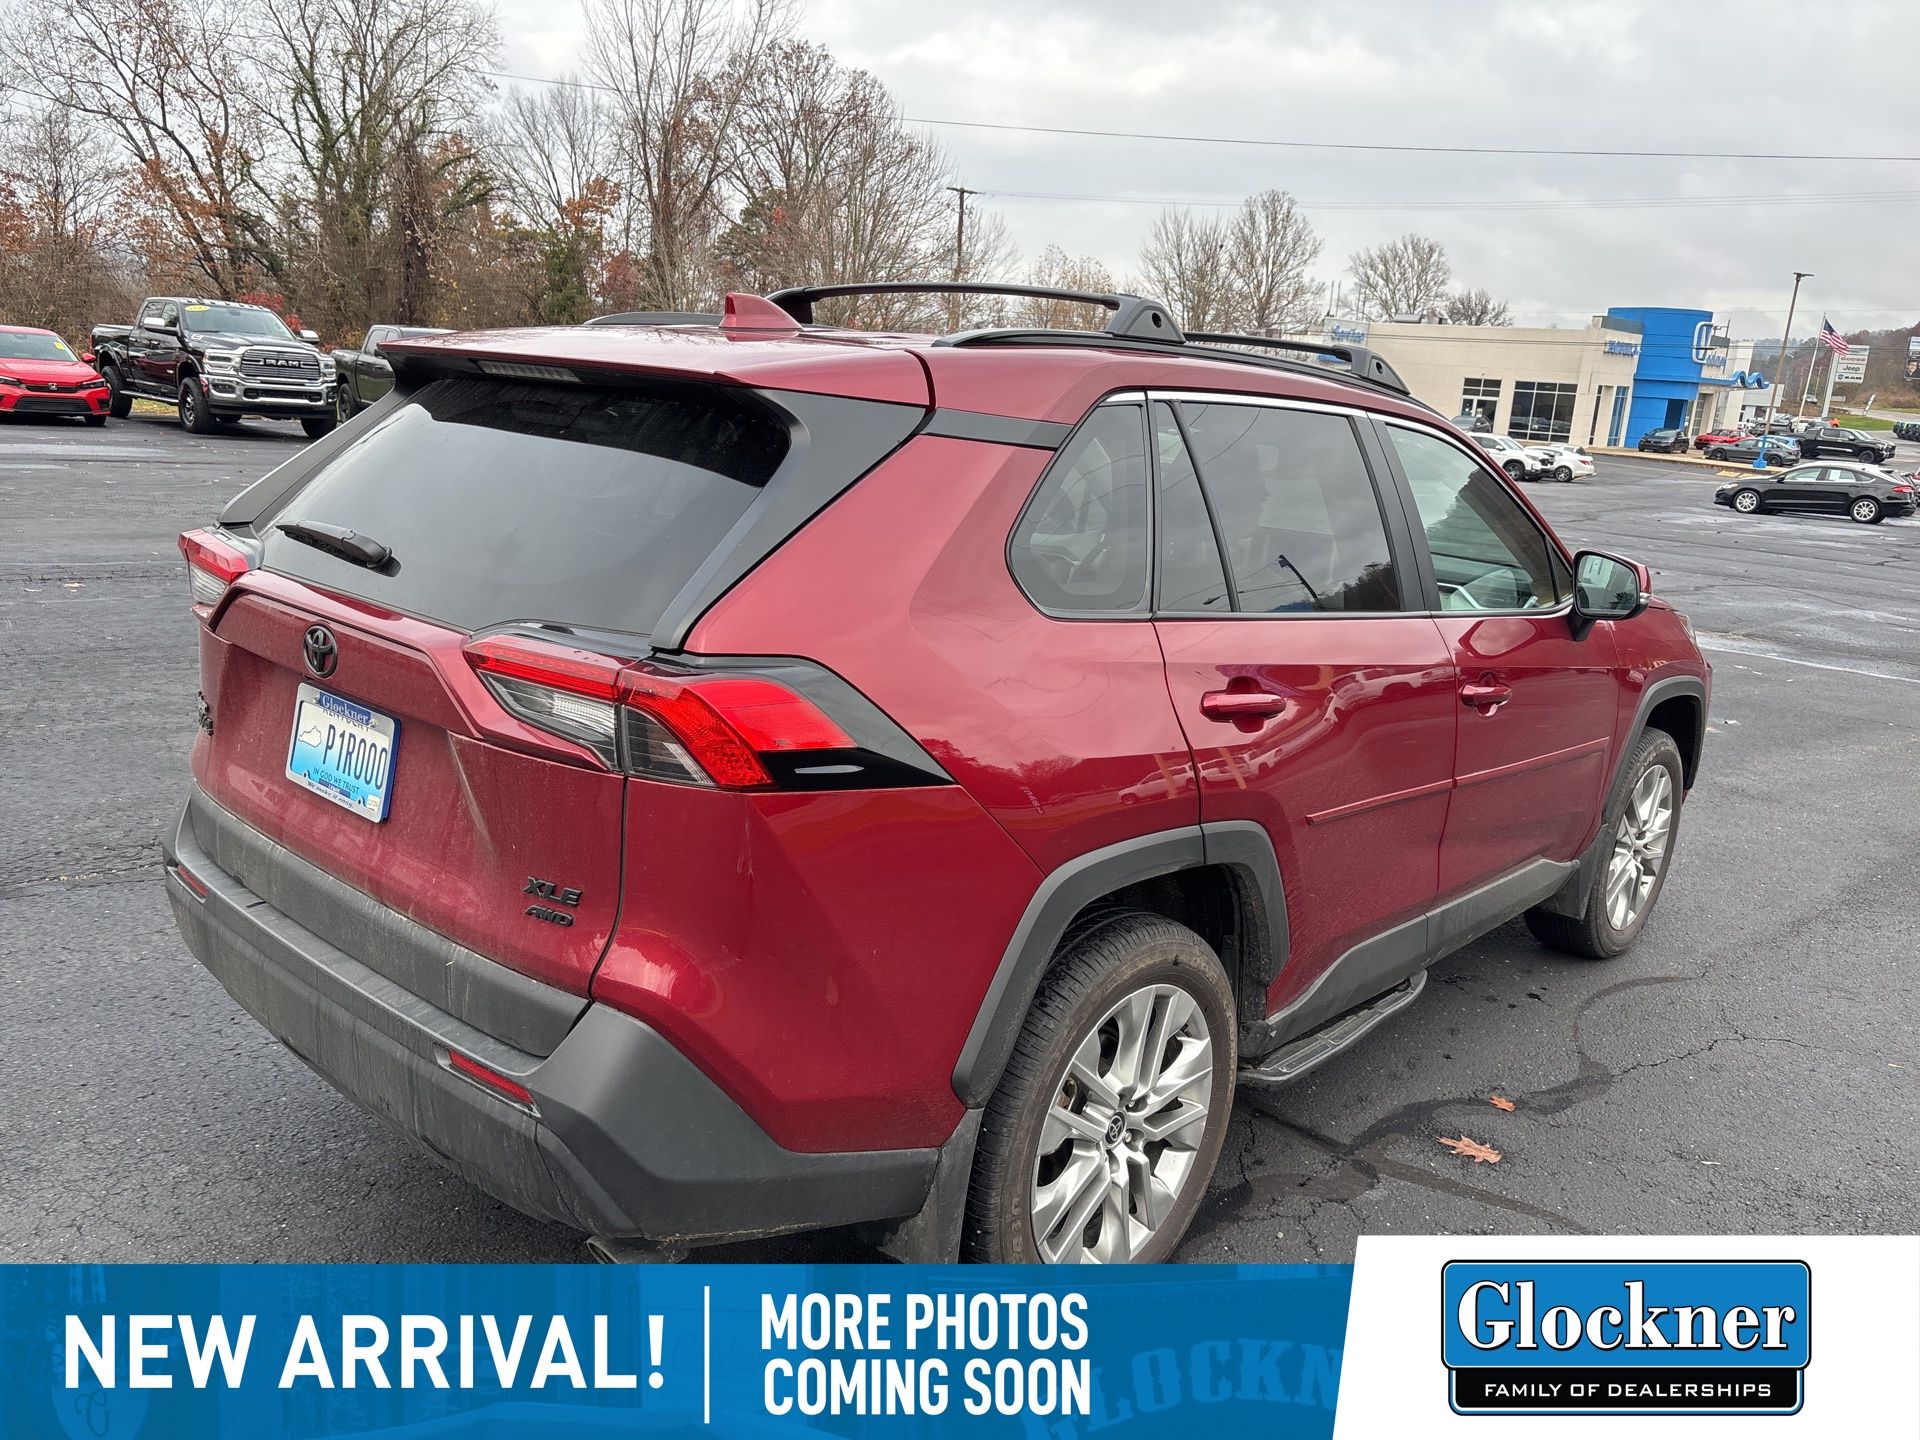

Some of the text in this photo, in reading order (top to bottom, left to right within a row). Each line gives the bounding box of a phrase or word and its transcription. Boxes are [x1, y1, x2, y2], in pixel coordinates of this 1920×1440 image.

[264, 358, 300, 368] RAM
[1843, 365, 1860, 373] Jeep
[322, 694, 369, 725] Glockner
[322, 724, 388, 791] P1R000
[307, 781, 316, 789] We
[316, 786, 332, 797] make
[312, 767, 320, 775] IN
[320, 770, 333, 781] GOD
[333, 776, 342, 787] WE
[342, 780, 360, 795] TRUST
[523, 876, 583, 907] XLE
[524, 905, 575, 927] AWD
